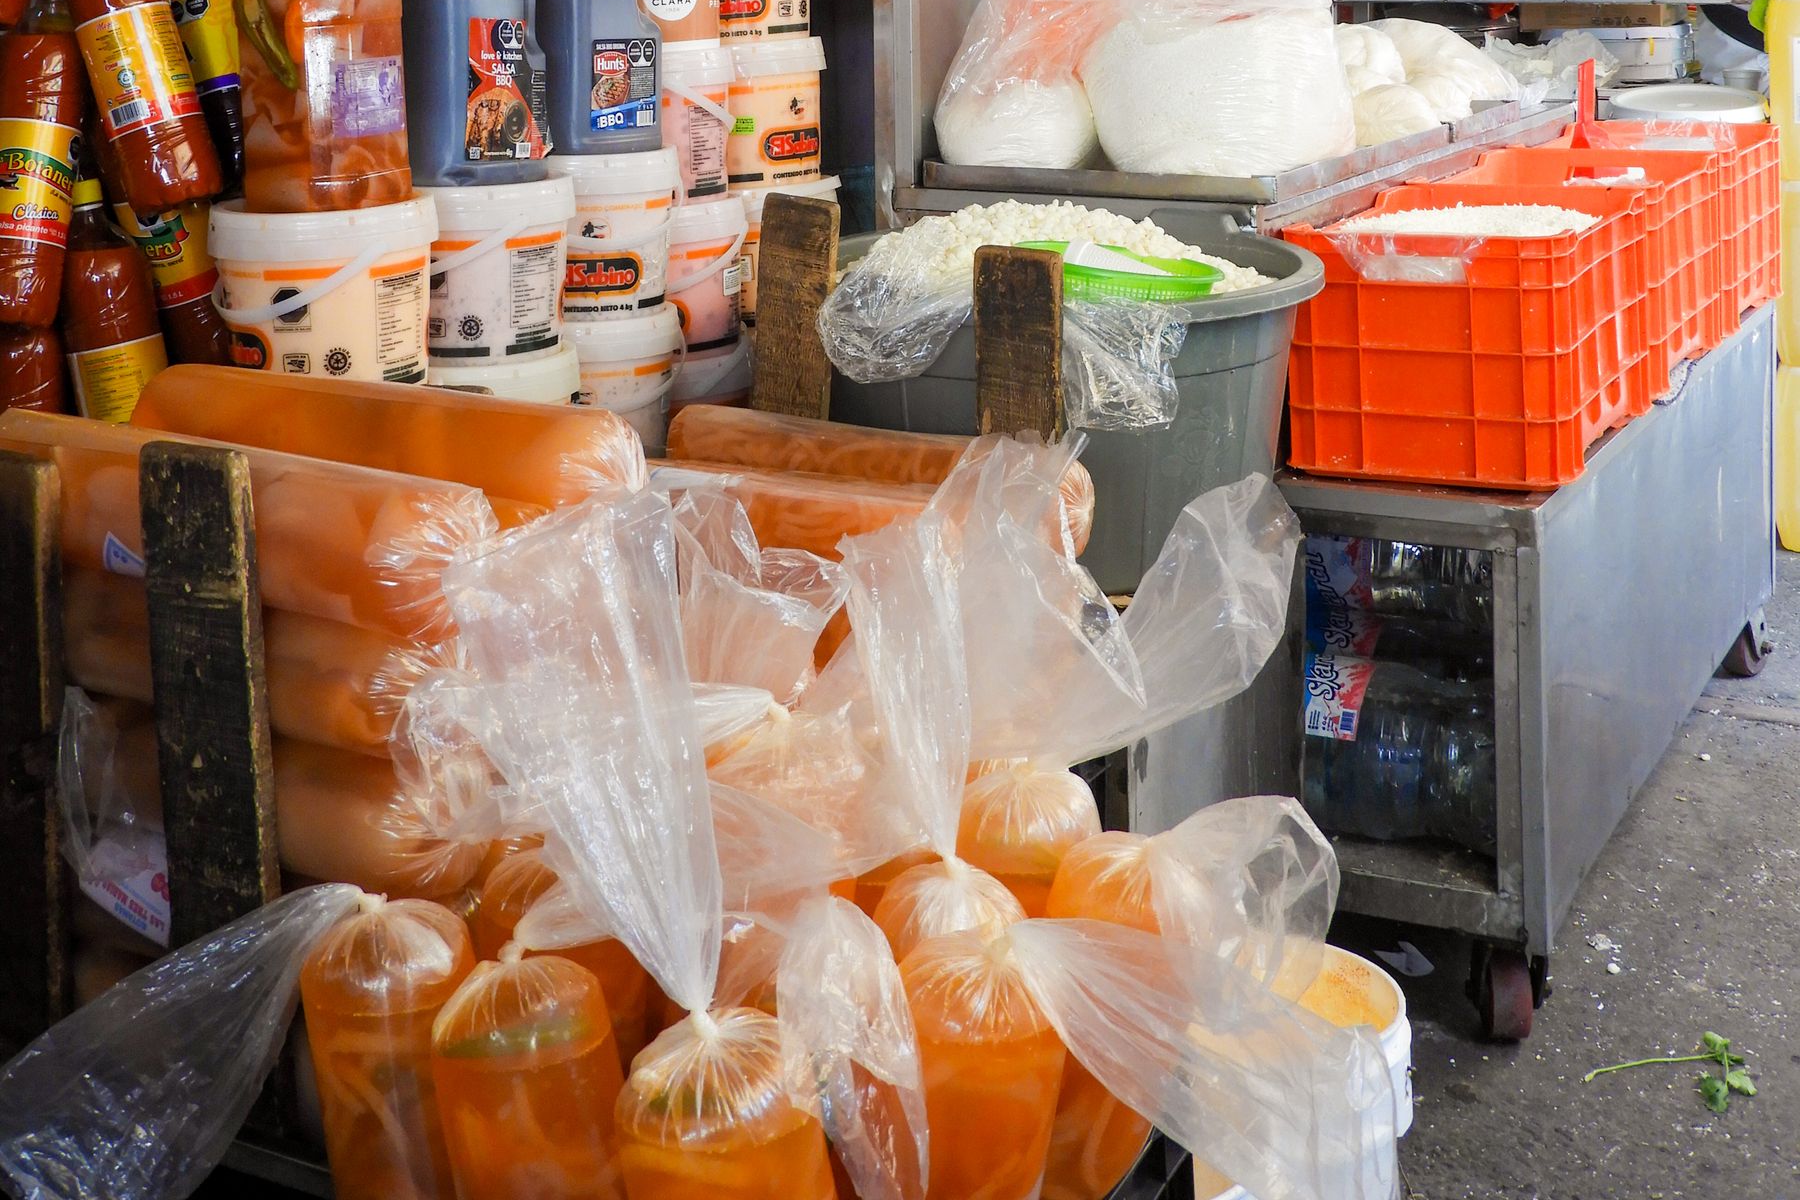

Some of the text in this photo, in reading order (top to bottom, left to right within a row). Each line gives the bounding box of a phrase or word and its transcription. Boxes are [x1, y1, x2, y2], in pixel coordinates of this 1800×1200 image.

[481, 50, 496, 60] love
[502, 49, 523, 61] kitchen
[491, 63, 516, 75] SALSA
[597, 57, 625, 71] Hunt's
[495, 74, 513, 87] BBQ
[600, 112, 624, 128] BBQ
[773, 170, 803, 180] CONTENIDO
[12, 202, 58, 220] Clásica
[16, 223, 48, 235] picante
[600, 304, 619, 312] NETO
[625, 303, 633, 312] kg
[329, 347, 351, 359] BASURA
[338, 361, 352, 376] LUGAR
